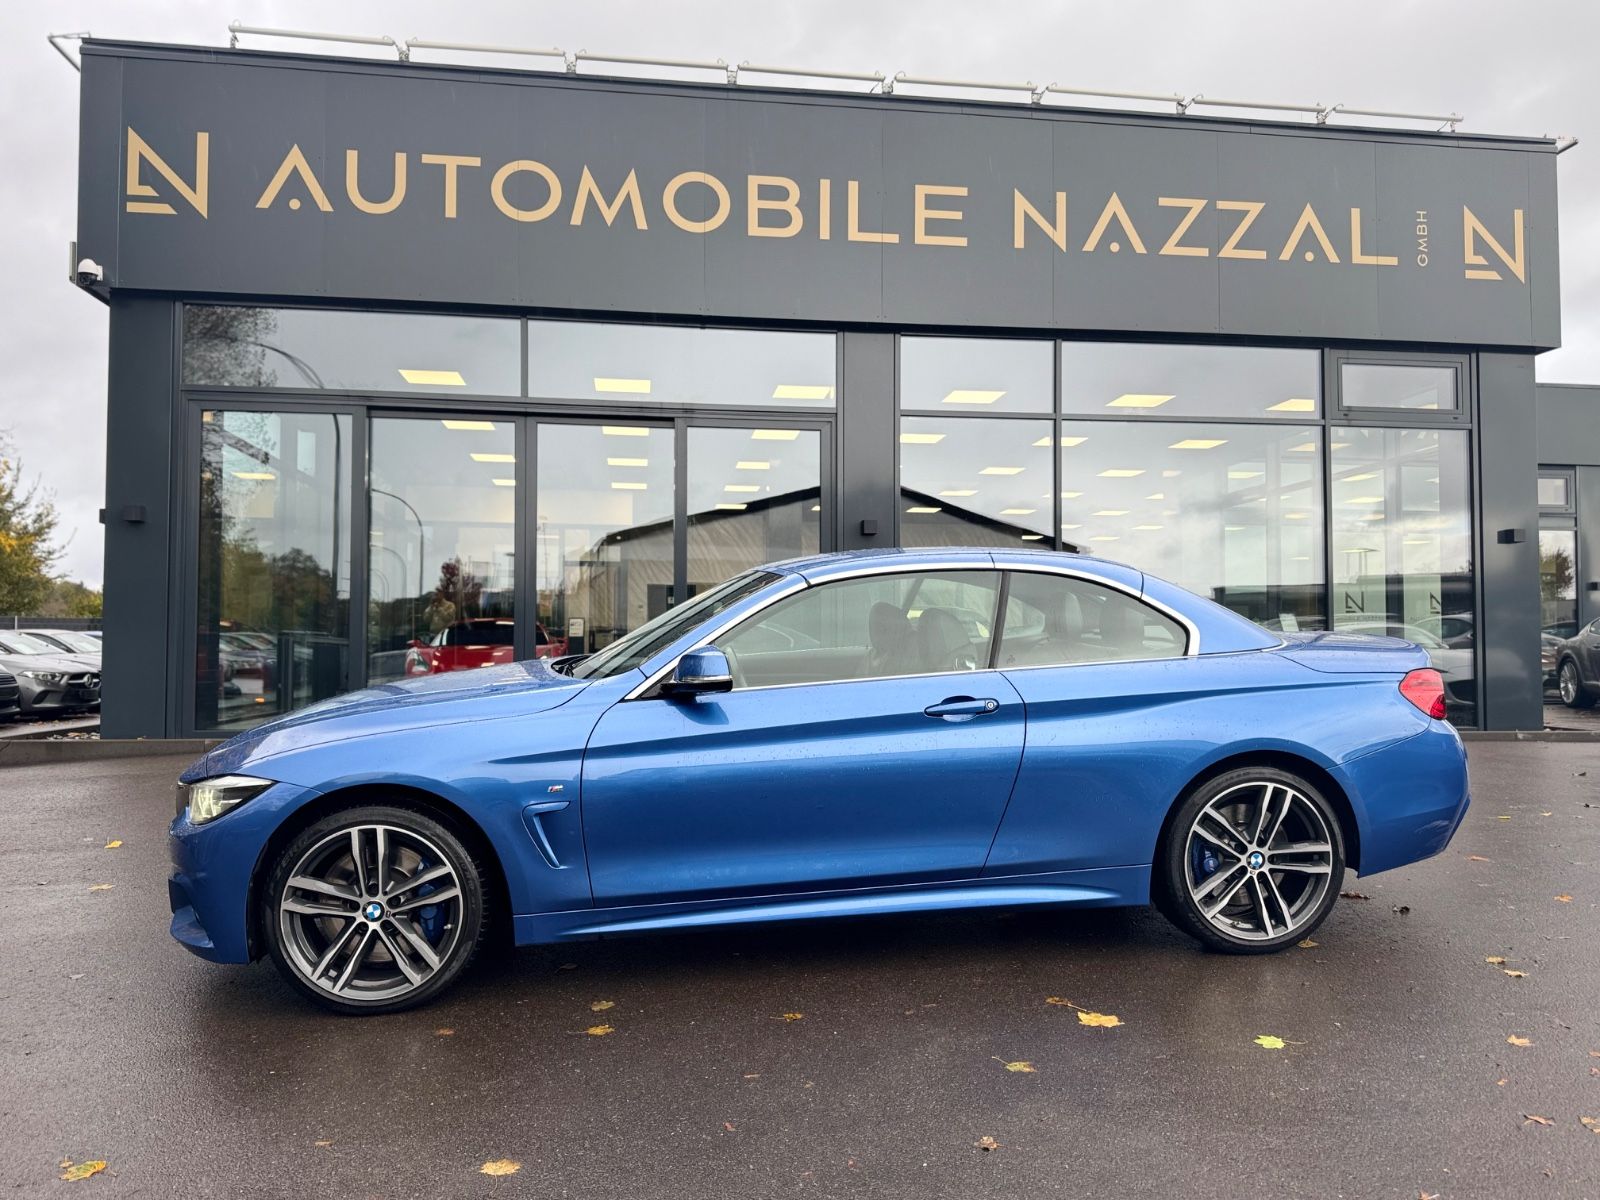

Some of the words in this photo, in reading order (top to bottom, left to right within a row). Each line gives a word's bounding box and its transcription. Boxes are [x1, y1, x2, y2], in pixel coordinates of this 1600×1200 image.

[256, 144, 968, 247] AUTOMOBILE
[1013, 188, 1398, 266] NAZZAL
[1416, 210, 1428, 267] GMBH
